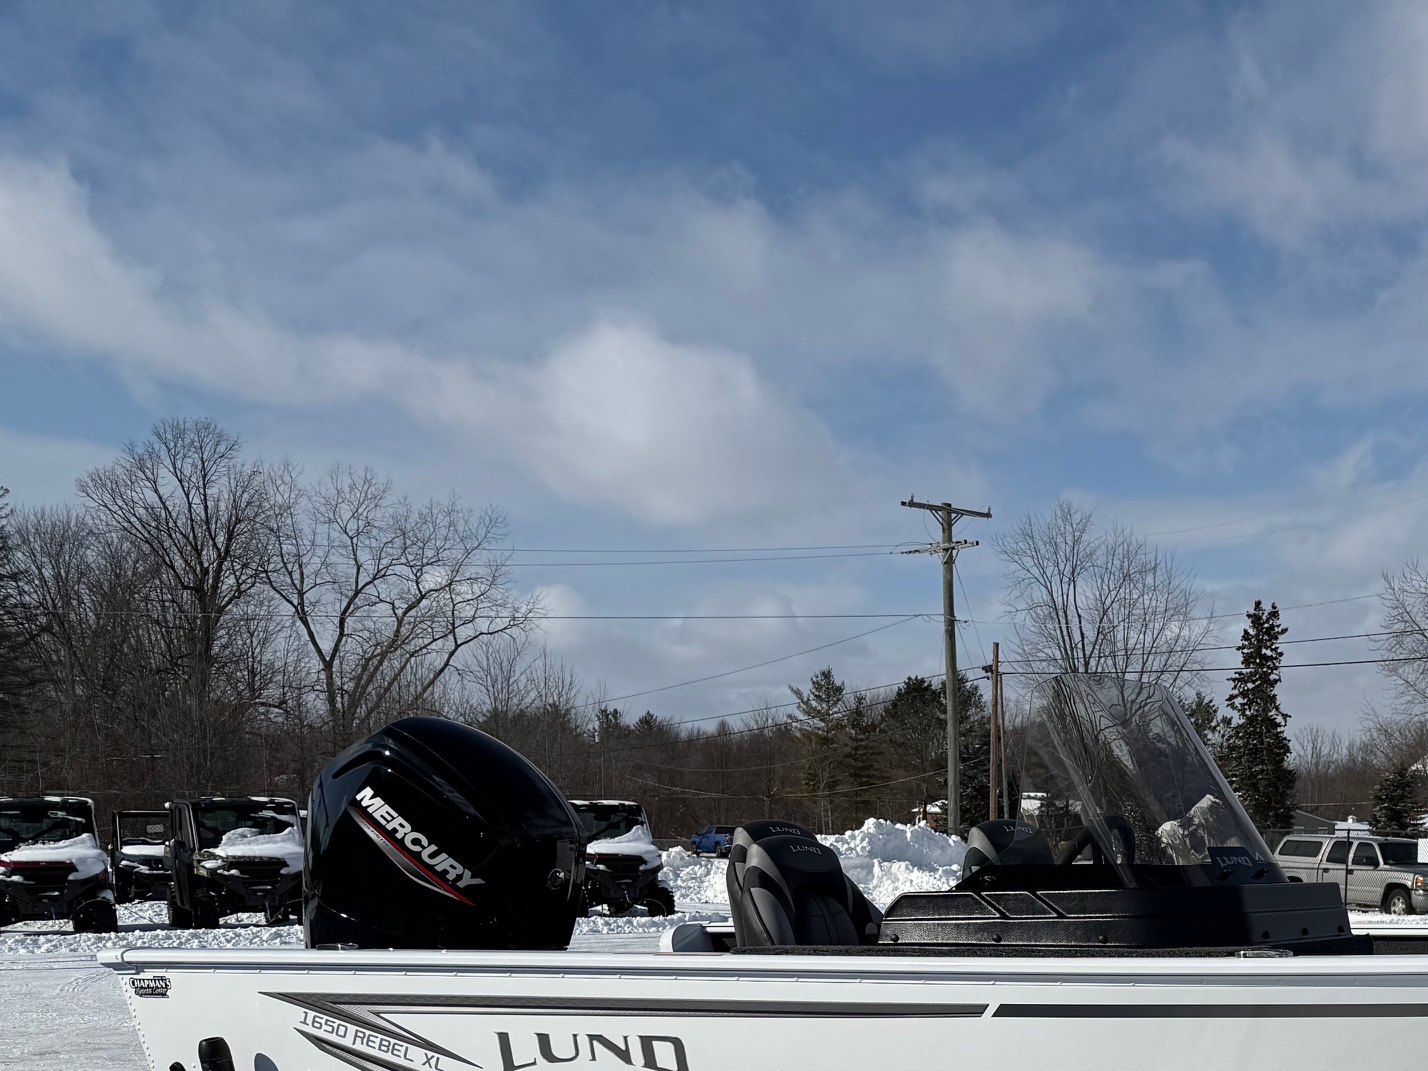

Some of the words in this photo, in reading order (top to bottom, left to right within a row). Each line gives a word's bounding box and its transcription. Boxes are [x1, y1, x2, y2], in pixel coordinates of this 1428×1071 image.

[355, 786, 486, 888] MERCURY
[1215, 856, 1254, 868] LUND
[129, 978, 171, 988] CHAPMAN'S
[299, 1011, 349, 1039] 1650
[352, 1029, 415, 1063] REBEL
